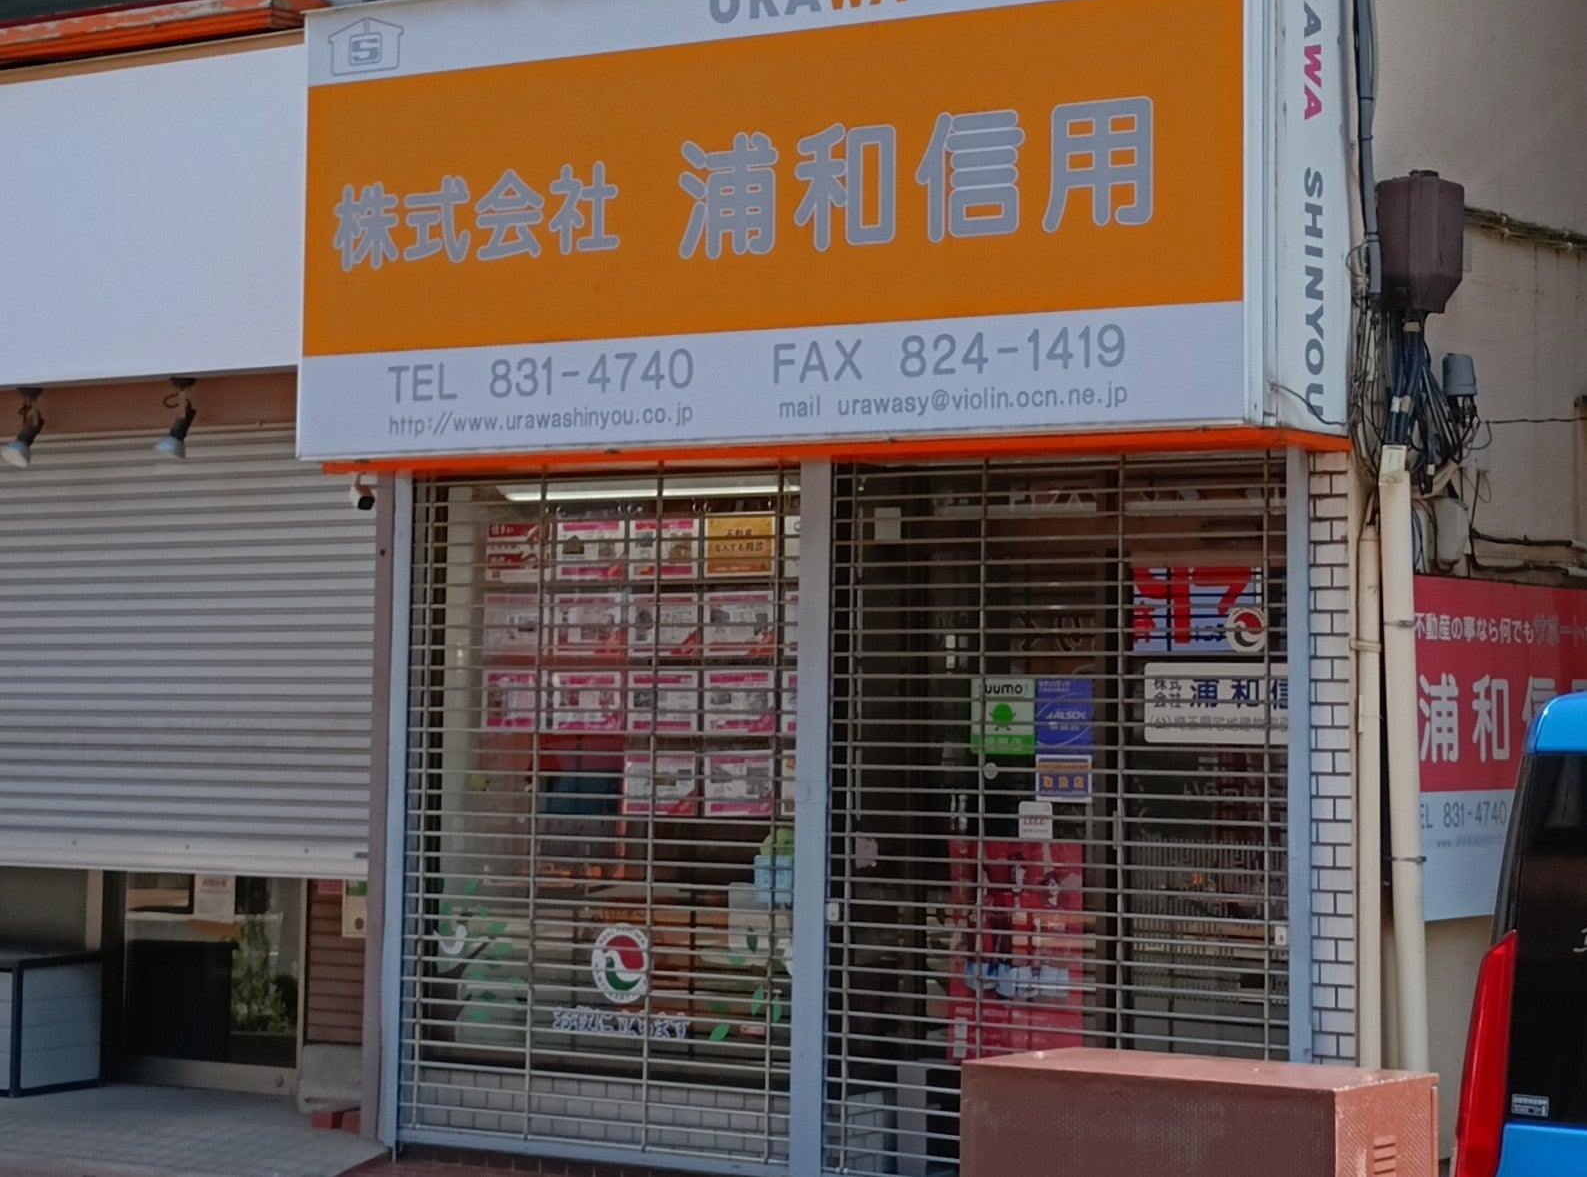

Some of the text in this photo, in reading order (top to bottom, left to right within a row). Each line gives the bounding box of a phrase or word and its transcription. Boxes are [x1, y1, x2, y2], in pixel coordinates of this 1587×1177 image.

[332, 95, 1154, 273] 株式会社 浦和信用
[1302, 166, 1325, 418] SHINYOU
[387, 323, 1126, 405] TEL 831-4740 FAX 824-1419
[388, 383, 1128, 438] http://www.urawashinyou.co.jp mail urawasy@violin.ocn.ne.jp
